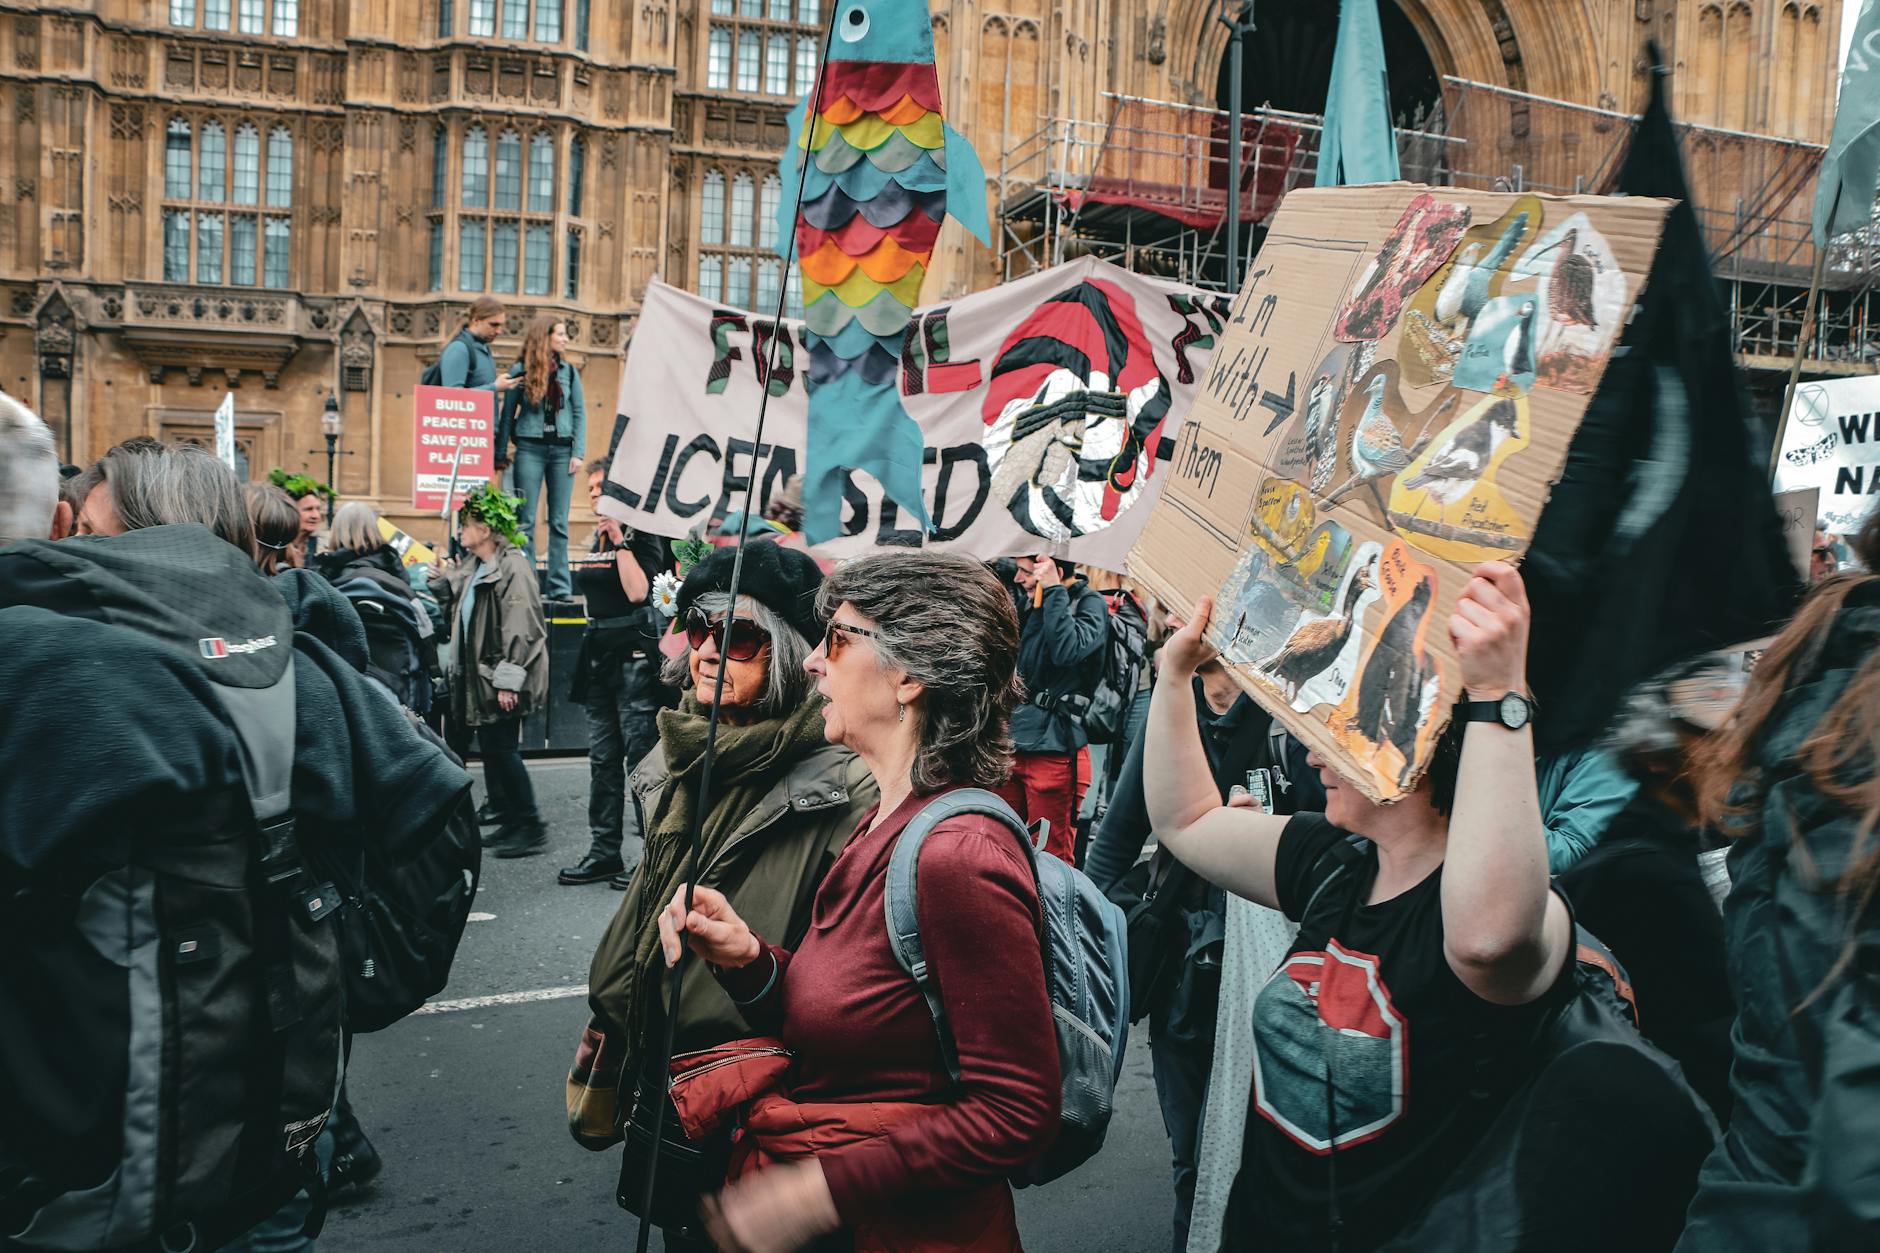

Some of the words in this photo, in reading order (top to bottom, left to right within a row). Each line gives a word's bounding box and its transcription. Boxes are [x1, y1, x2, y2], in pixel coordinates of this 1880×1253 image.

[1233, 264, 1278, 337] I'm
[1207, 345, 1269, 421] With
[435, 398, 476, 412] BUILD
[422, 415, 467, 430] PEACE
[469, 418, 487, 430] TO
[421, 434, 457, 446] SAVE
[460, 436, 489, 449] OUR
